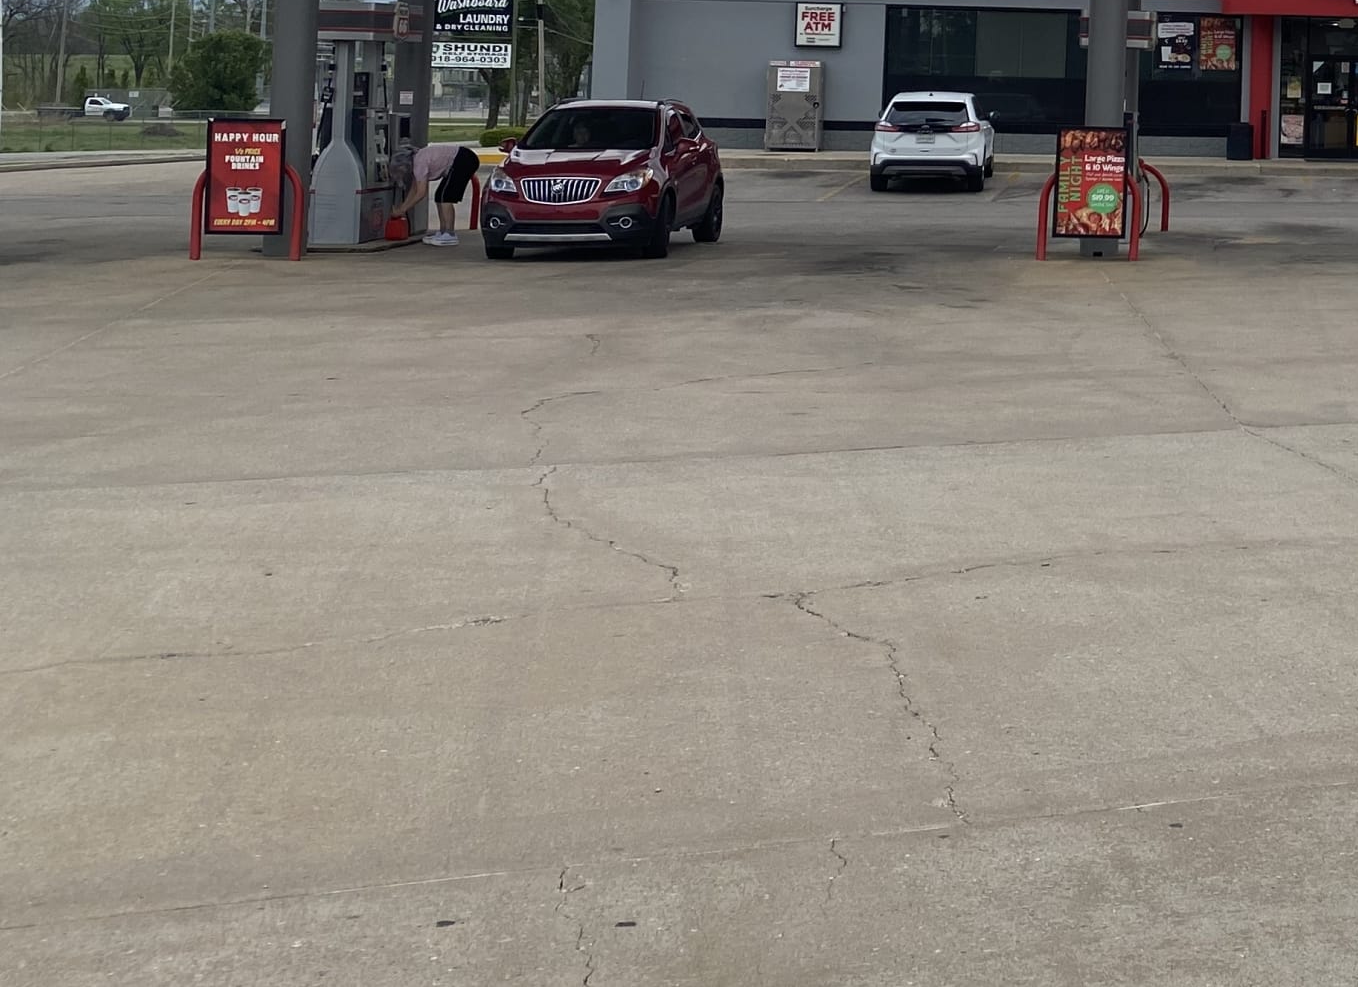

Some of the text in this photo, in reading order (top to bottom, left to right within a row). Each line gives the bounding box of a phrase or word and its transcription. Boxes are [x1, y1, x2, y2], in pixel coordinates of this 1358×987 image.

[460, 14, 510, 24] LAUNDRY
[801, 12, 835, 21] FREE
[804, 22, 832, 31] ATM
[443, 44, 508, 53] SHUNDI
[214, 133, 279, 142] HAPPY HOUR
[1085, 155, 1125, 163] Large Pizza
[1102, 165, 1124, 173] Wings
[1070, 156, 1082, 201] NIGHT
[1058, 156, 1071, 212] FAMILY
